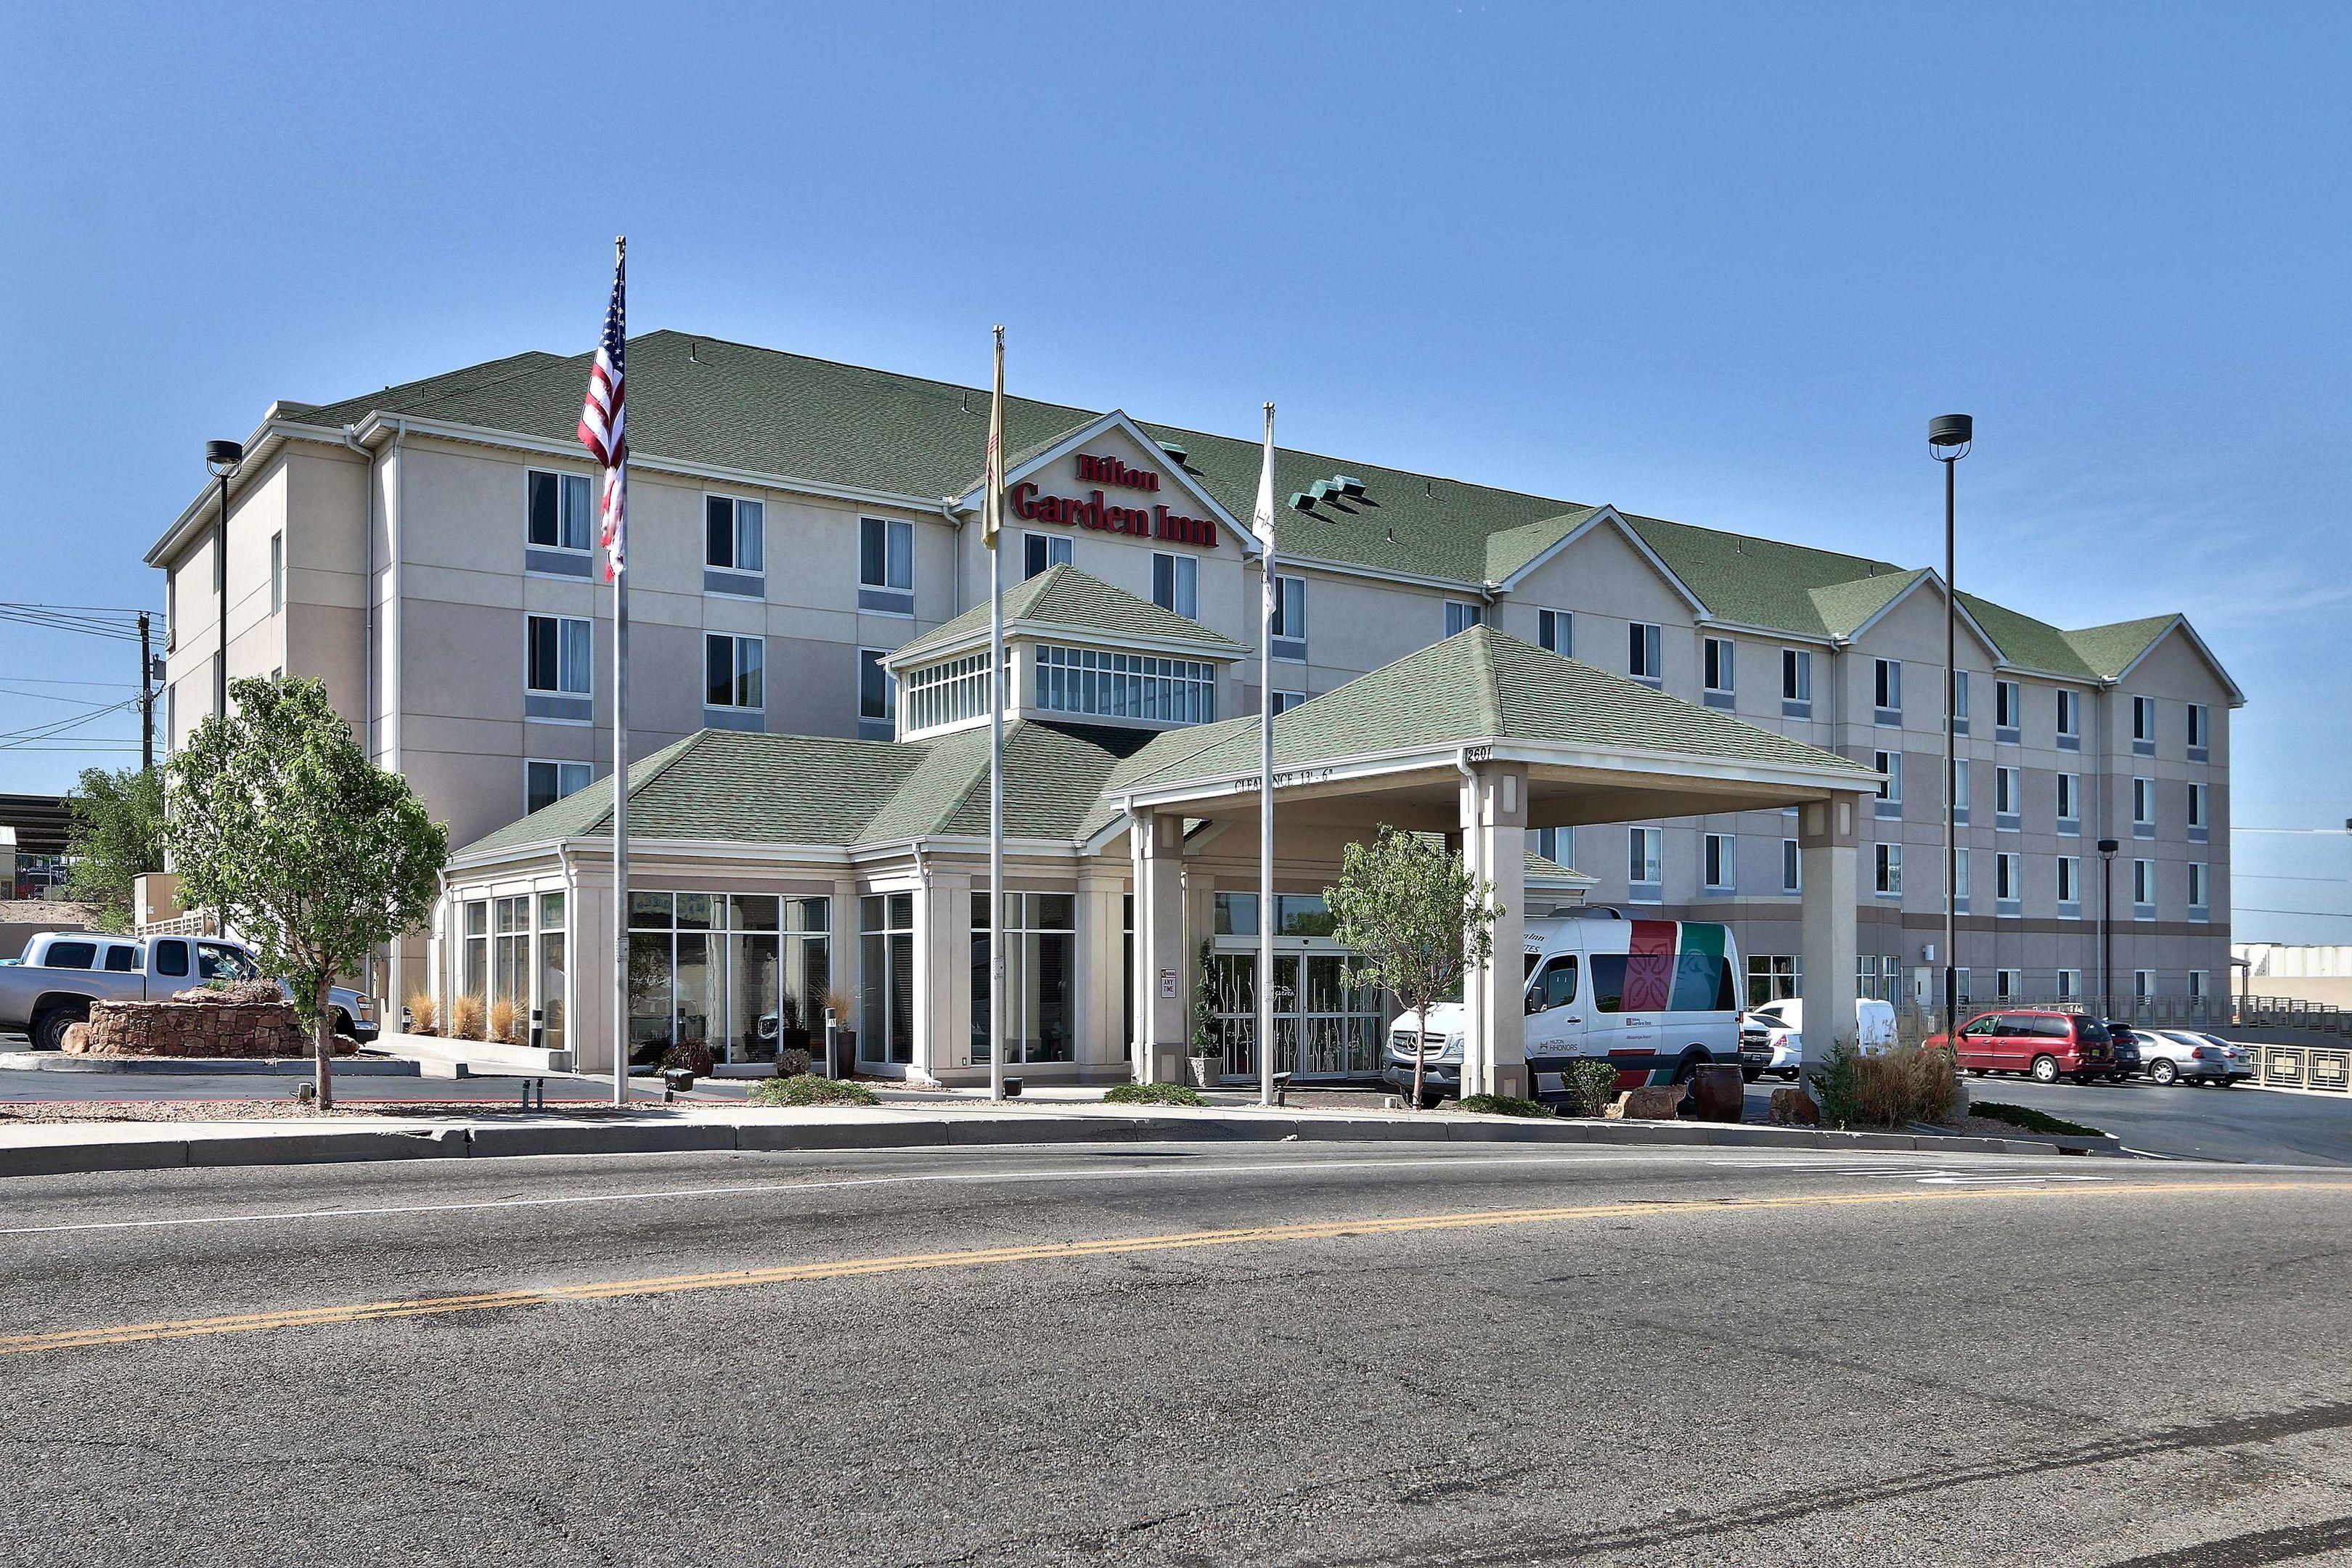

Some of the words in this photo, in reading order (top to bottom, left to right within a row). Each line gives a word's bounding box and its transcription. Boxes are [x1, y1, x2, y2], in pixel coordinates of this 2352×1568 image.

[1076, 452, 1161, 492] Hilton
[1012, 481, 1151, 538] Garden
[1153, 503, 1220, 548] Inn
[1467, 746, 1492, 761] 2601
[1234, 773, 1293, 793] CLEANCE
